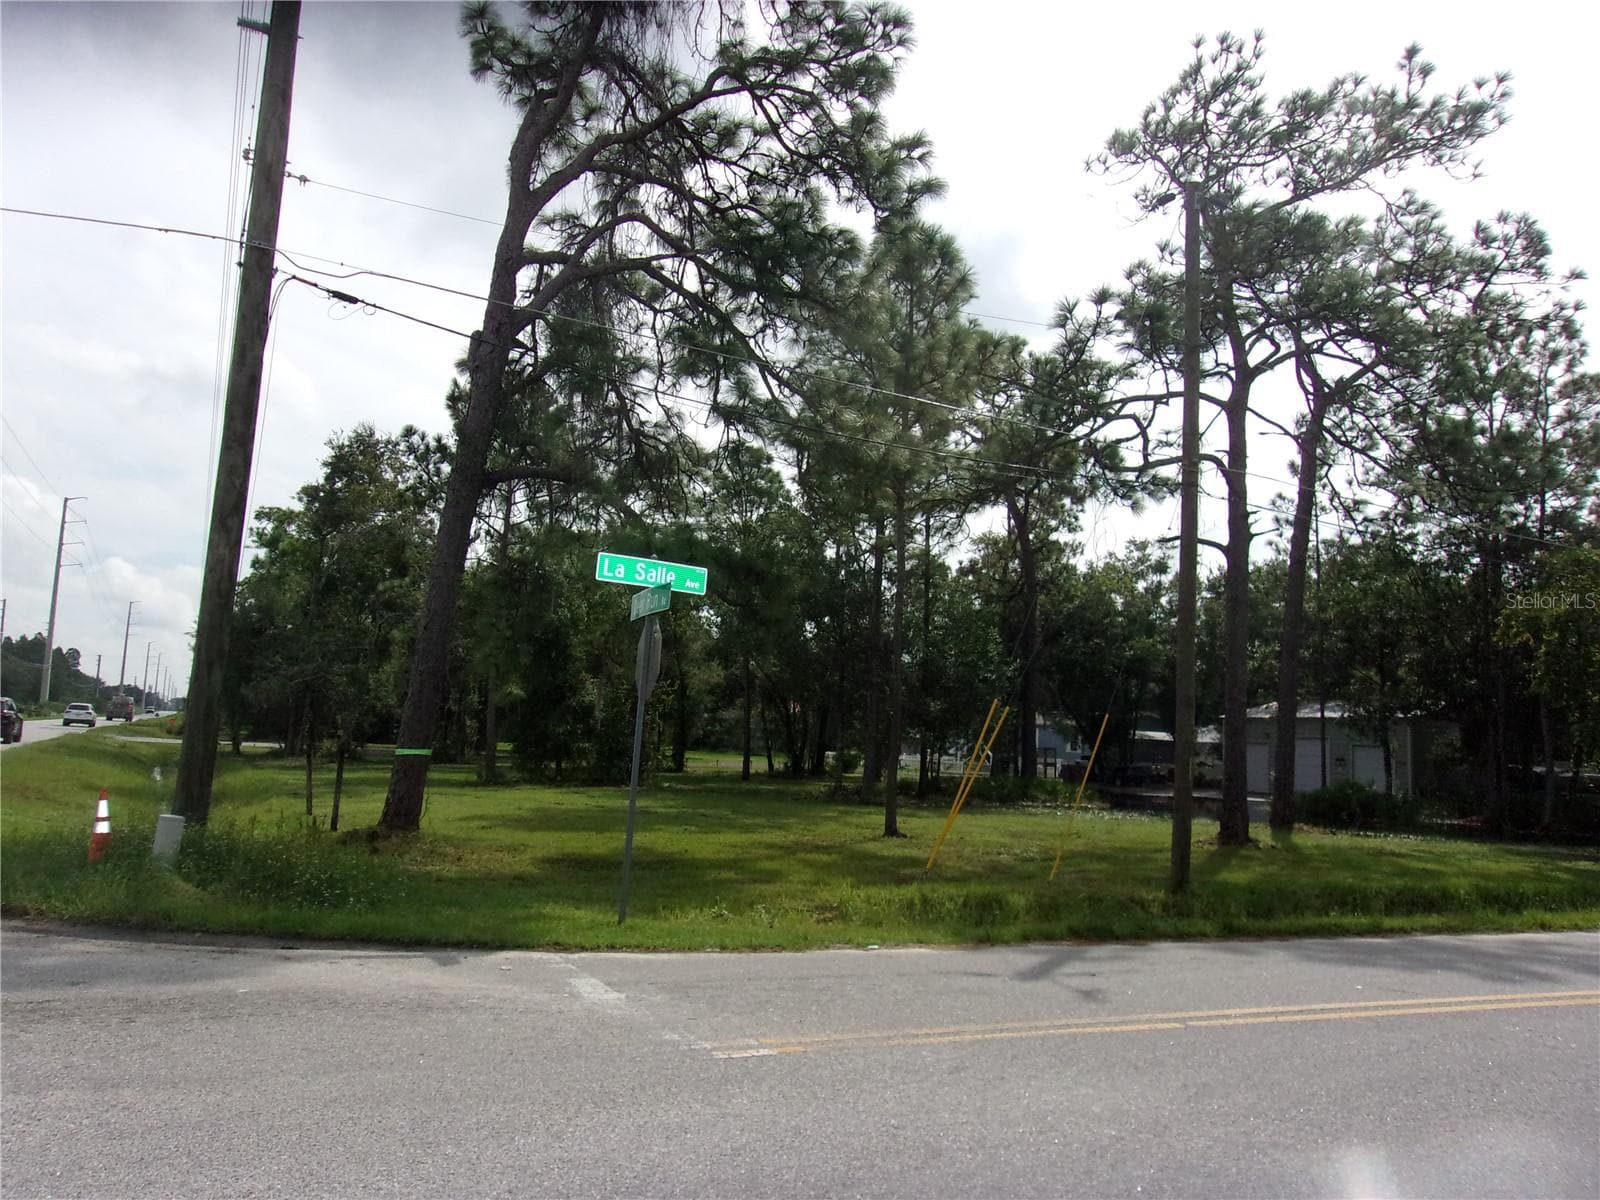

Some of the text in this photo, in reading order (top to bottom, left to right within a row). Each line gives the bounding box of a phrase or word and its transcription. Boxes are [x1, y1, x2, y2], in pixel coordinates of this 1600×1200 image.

[603, 558, 700, 589] La Salle Ave
